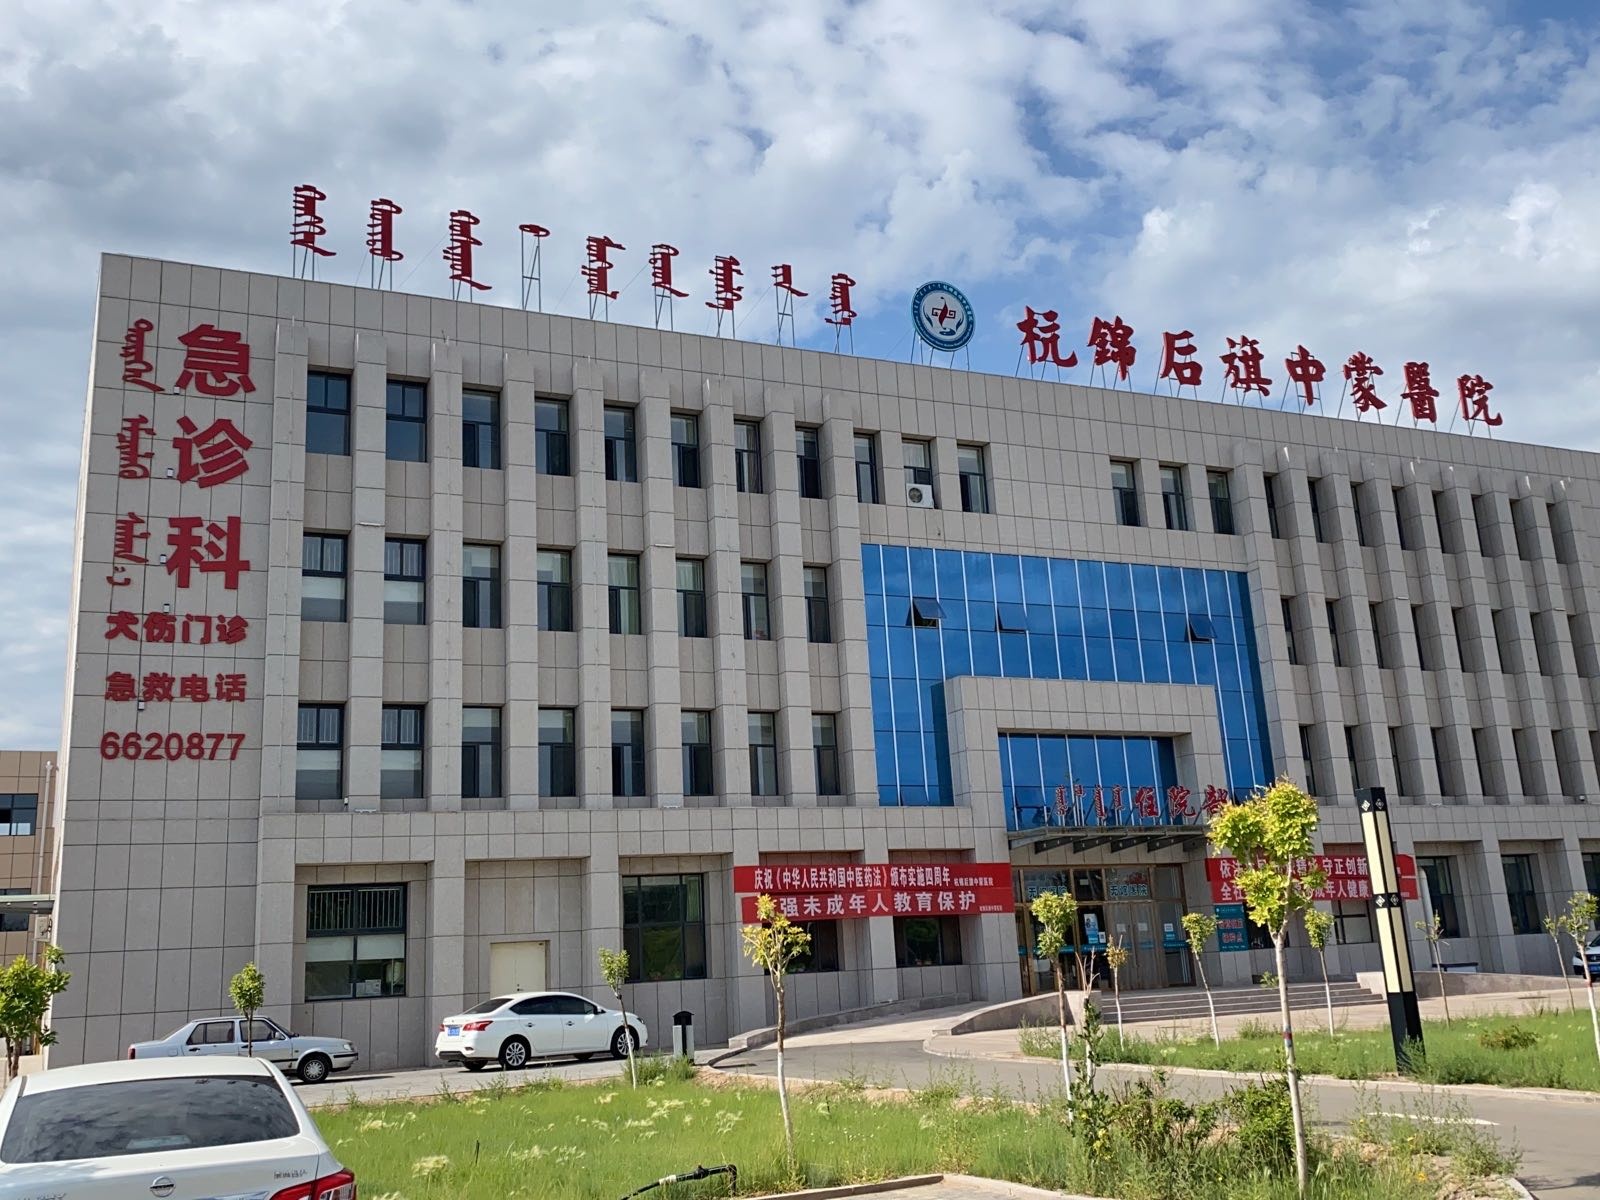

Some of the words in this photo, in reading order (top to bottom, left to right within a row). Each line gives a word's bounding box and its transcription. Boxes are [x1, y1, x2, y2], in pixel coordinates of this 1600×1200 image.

[166, 323, 256, 590] 急诊科
[104, 671, 247, 703] 急救电话
[100, 731, 246, 761] 6620877
[759, 890, 976, 917] 强未成年人教育保护
